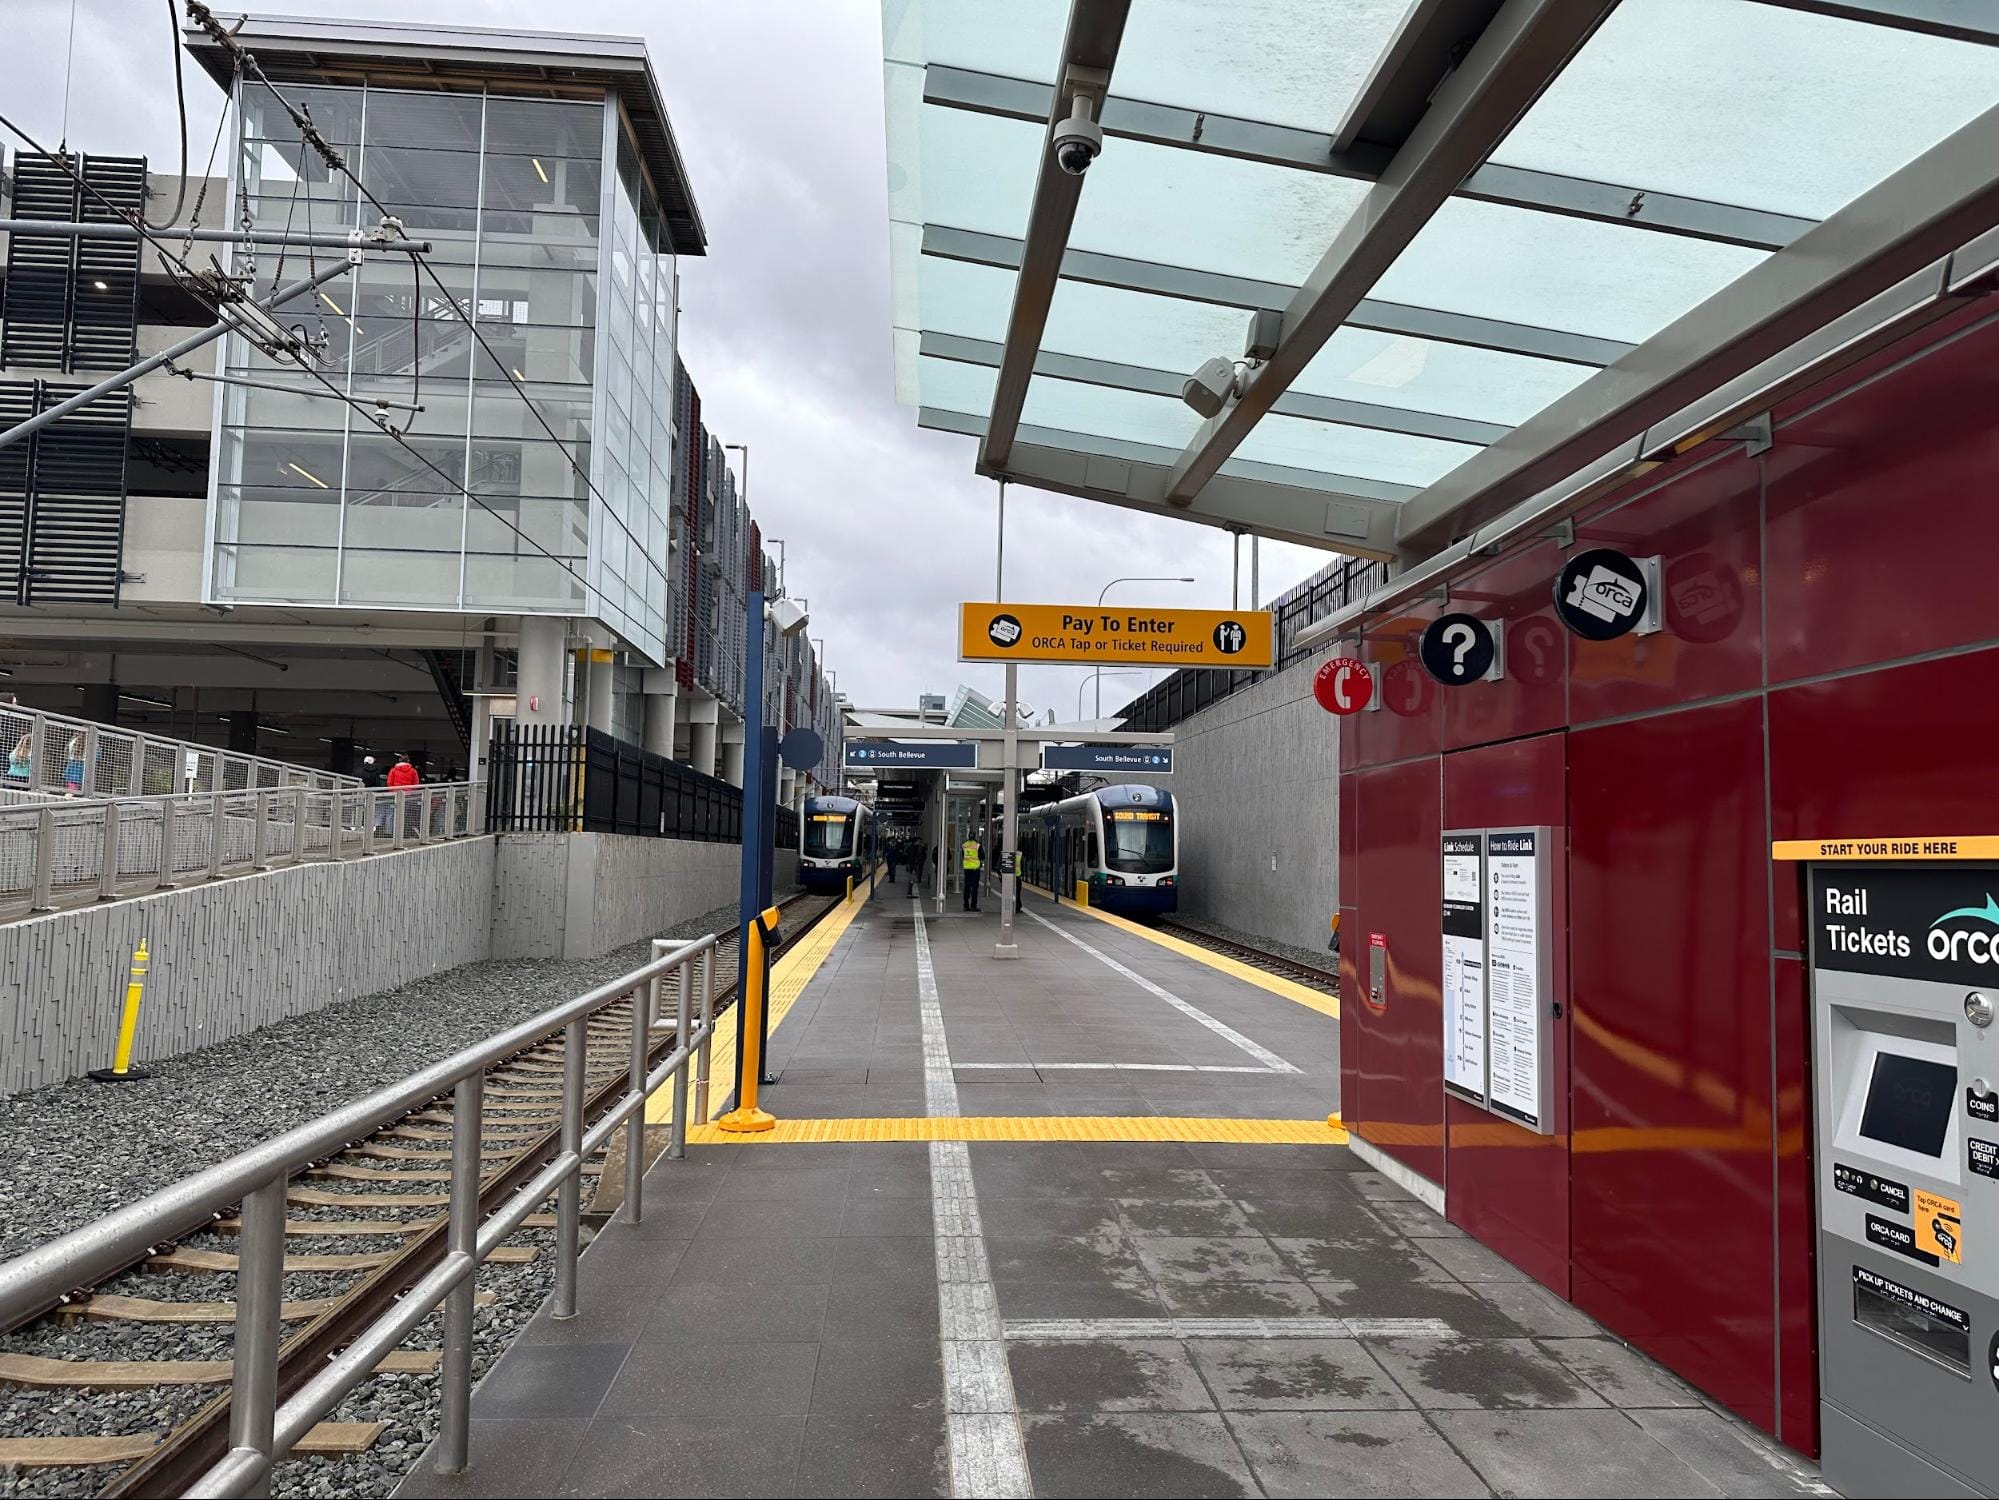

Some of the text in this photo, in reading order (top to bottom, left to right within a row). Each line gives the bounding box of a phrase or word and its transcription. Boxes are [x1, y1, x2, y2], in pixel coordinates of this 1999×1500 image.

[1595, 583, 1633, 608] orca
[1062, 615, 1175, 635] Pay To Enter
[1032, 637, 1203, 655] ORCA Tap or Ticket Required
[1442, 623, 1476, 676] ?
[1319, 659, 1370, 680] EMERGENCY
[1115, 755, 1141, 763] Bellevue
[1443, 841, 1475, 852] Link Schedule
[1490, 838, 1533, 851] How to Ride Link
[1820, 842, 1957, 855] START YOUR RIDE HERE
[1826, 887, 1868, 916] Rail
[1825, 924, 1911, 958] Tickets
[1970, 1099, 1995, 1113] COINS
[1970, 1140, 1997, 1155] CREDIT
[1972, 1150, 1995, 1164] DEBIT
[1880, 1183, 1906, 1200] CANCEL
[1917, 1195, 1955, 1213] Tap ORCA card
[1870, 1222, 1911, 1244] ORCA CARD
[1937, 1232, 1953, 1249] orca
[1858, 1270, 1963, 1323] PICK UP TICKETS AND CHANGE
